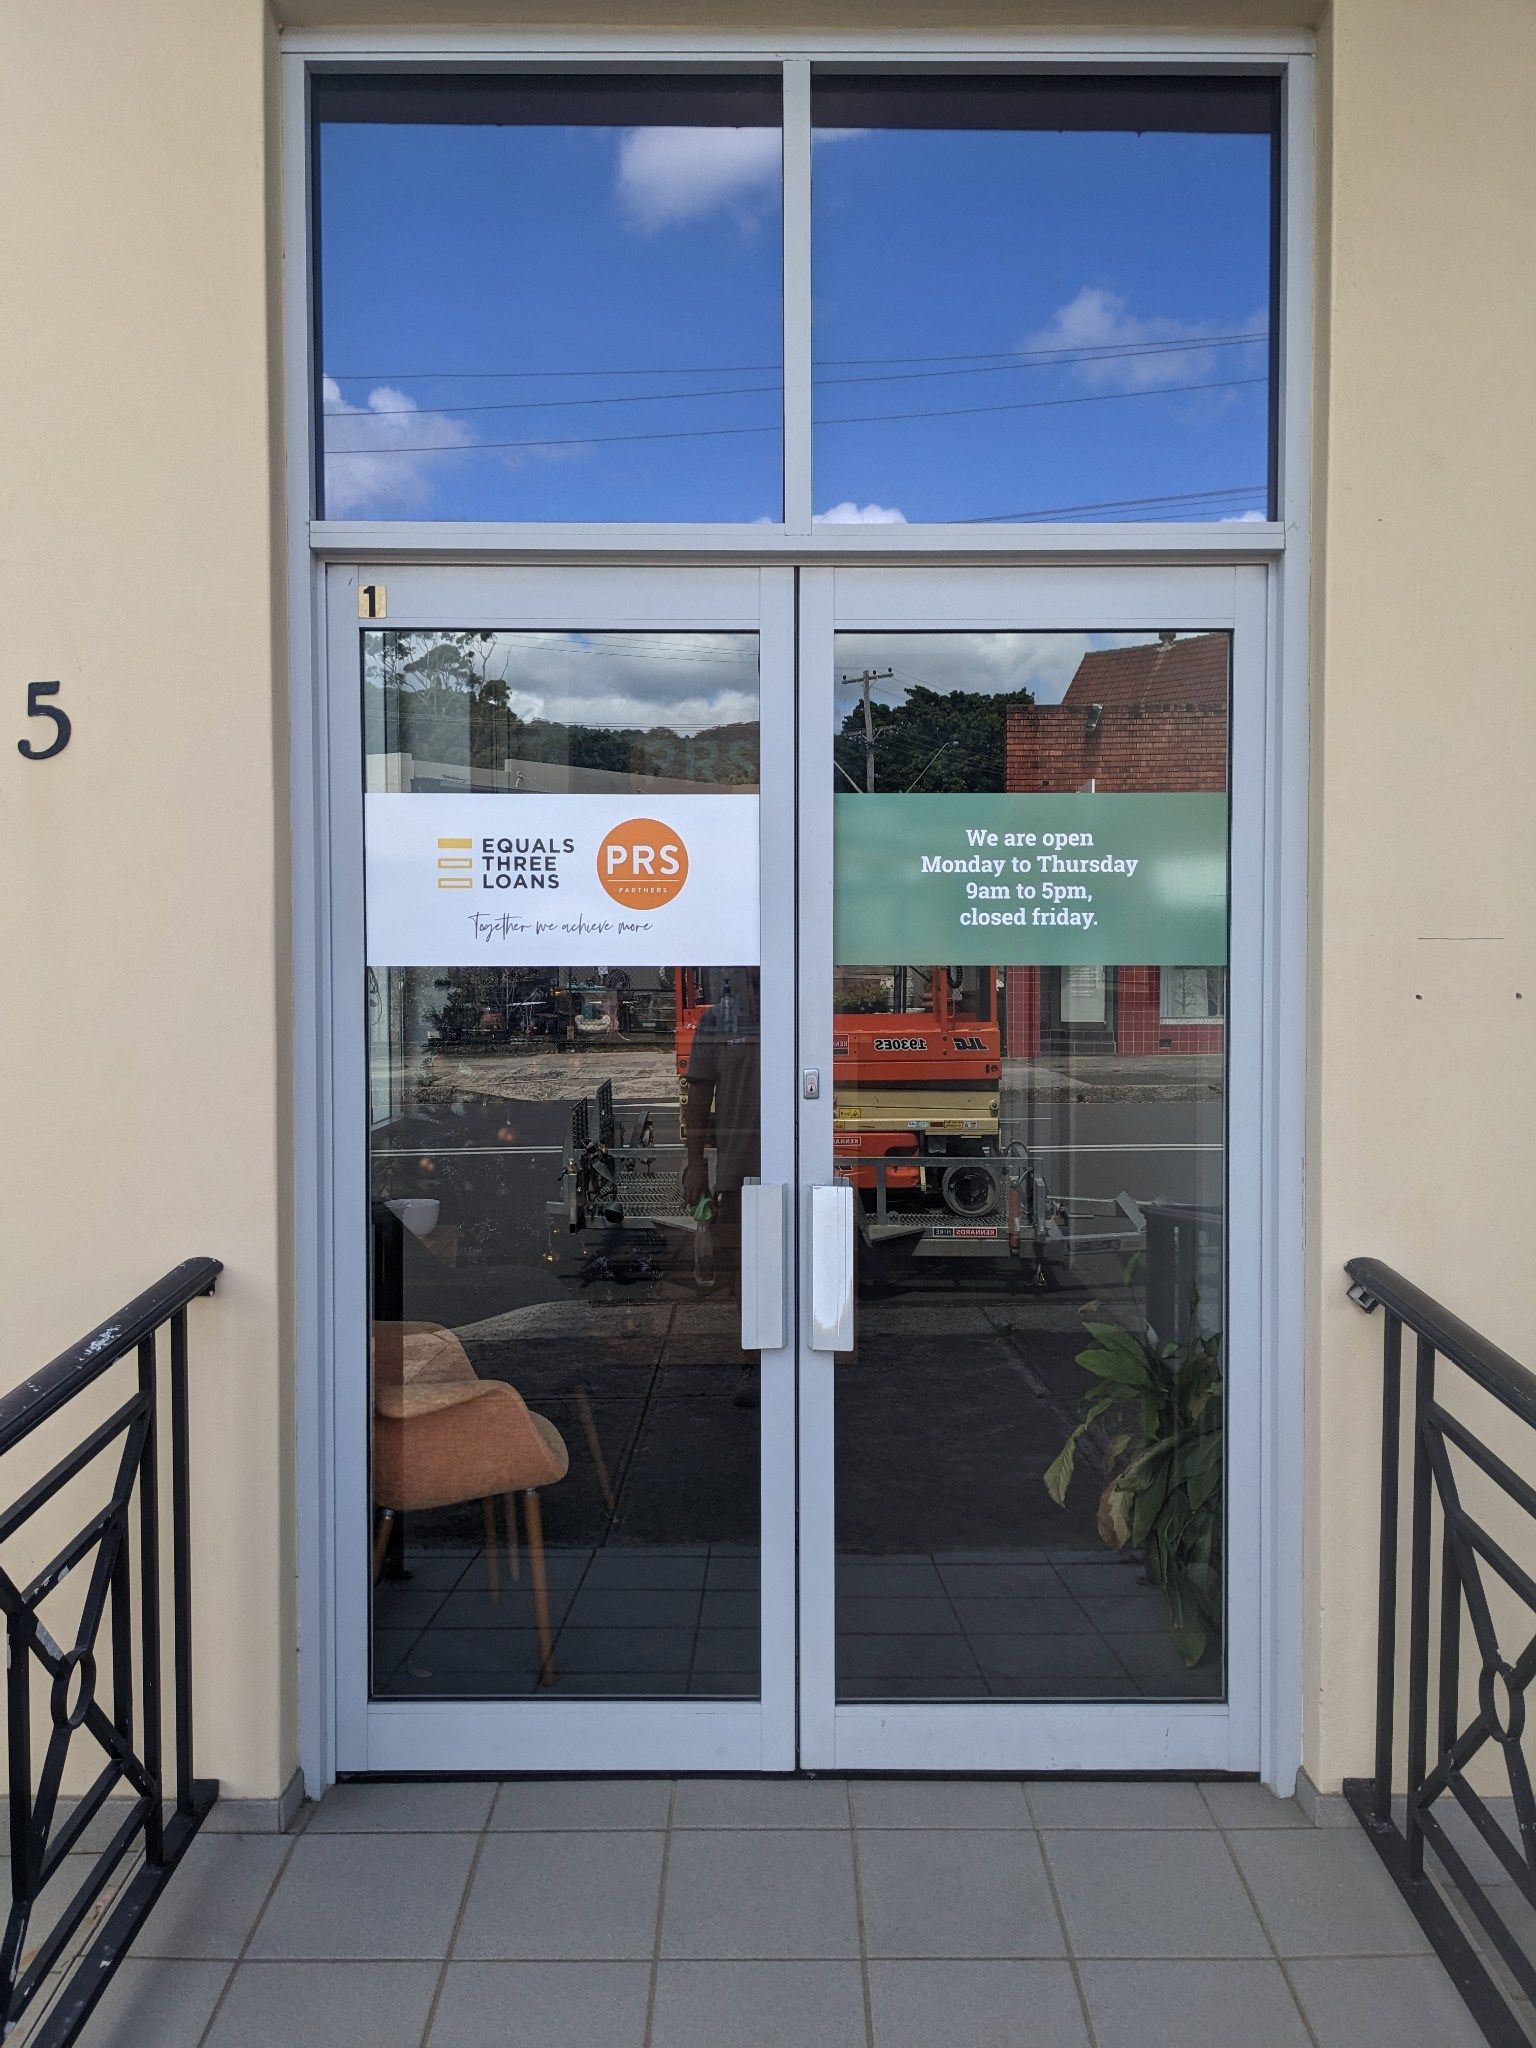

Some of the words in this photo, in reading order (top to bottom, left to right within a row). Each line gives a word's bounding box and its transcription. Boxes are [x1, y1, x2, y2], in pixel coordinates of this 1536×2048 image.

[363, 585, 376, 618] 1
[17, 680, 72, 761] 5
[482, 838, 575, 854] EQUALS
[966, 829, 998, 847] We
[1003, 832, 1037, 847] are
[1042, 832, 1094, 850] open
[482, 856, 557, 871] THREE
[607, 844, 680, 875] PRS
[921, 855, 1006, 877] Monday
[1011, 856, 1032, 873] to
[1036, 855, 1139, 877] Thursday
[483, 873, 560, 889] LOANS
[966, 882, 1010, 899] 9am
[1015, 883, 1036, 899] to
[1041, 882, 1093, 903] 5pm,
[468, 911, 532, 943] Together
[536, 921, 560, 935] we
[561, 912, 614, 936] achieve
[617, 921, 654, 935] more
[959, 907, 1026, 926] closed
[1032, 907, 1098, 930] friday.
